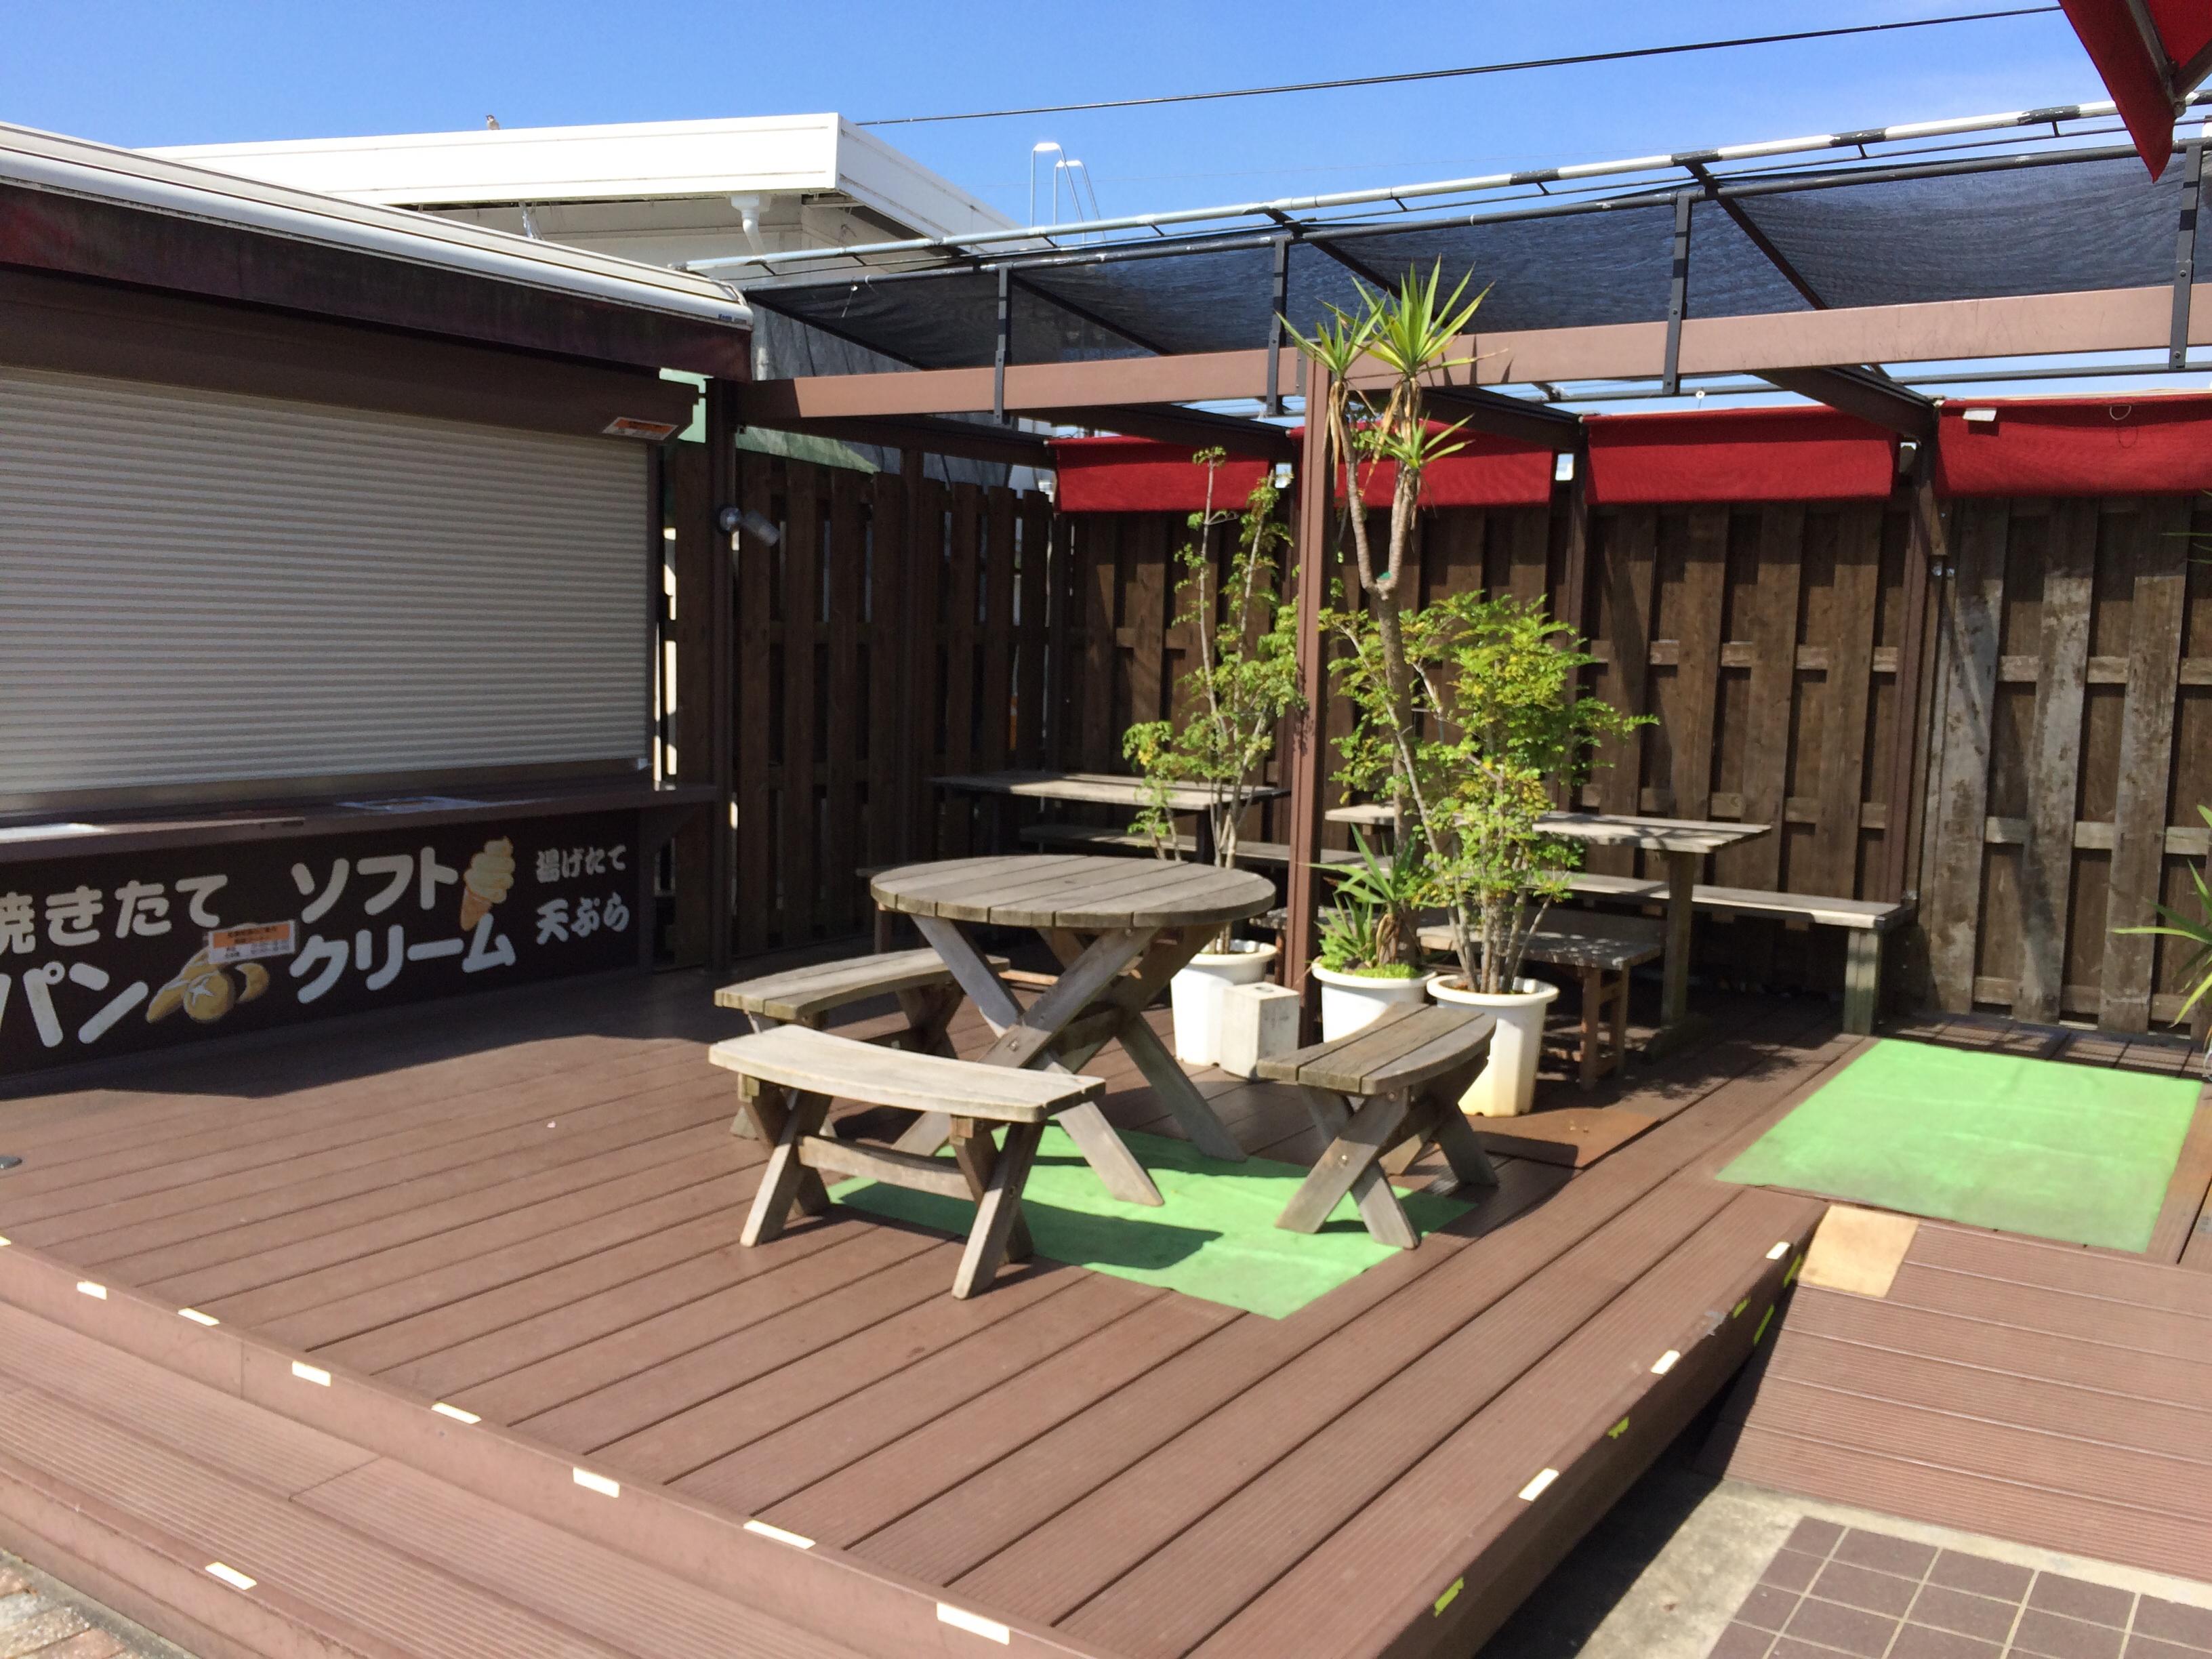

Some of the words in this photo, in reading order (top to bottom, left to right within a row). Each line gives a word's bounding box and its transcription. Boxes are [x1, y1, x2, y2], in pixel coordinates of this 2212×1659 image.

[291, 846, 459, 924] ソフト
[536, 891, 630, 945] 天ぷら
[289, 913, 516, 1004] クリーム
[0, 960, 148, 1048] パン
